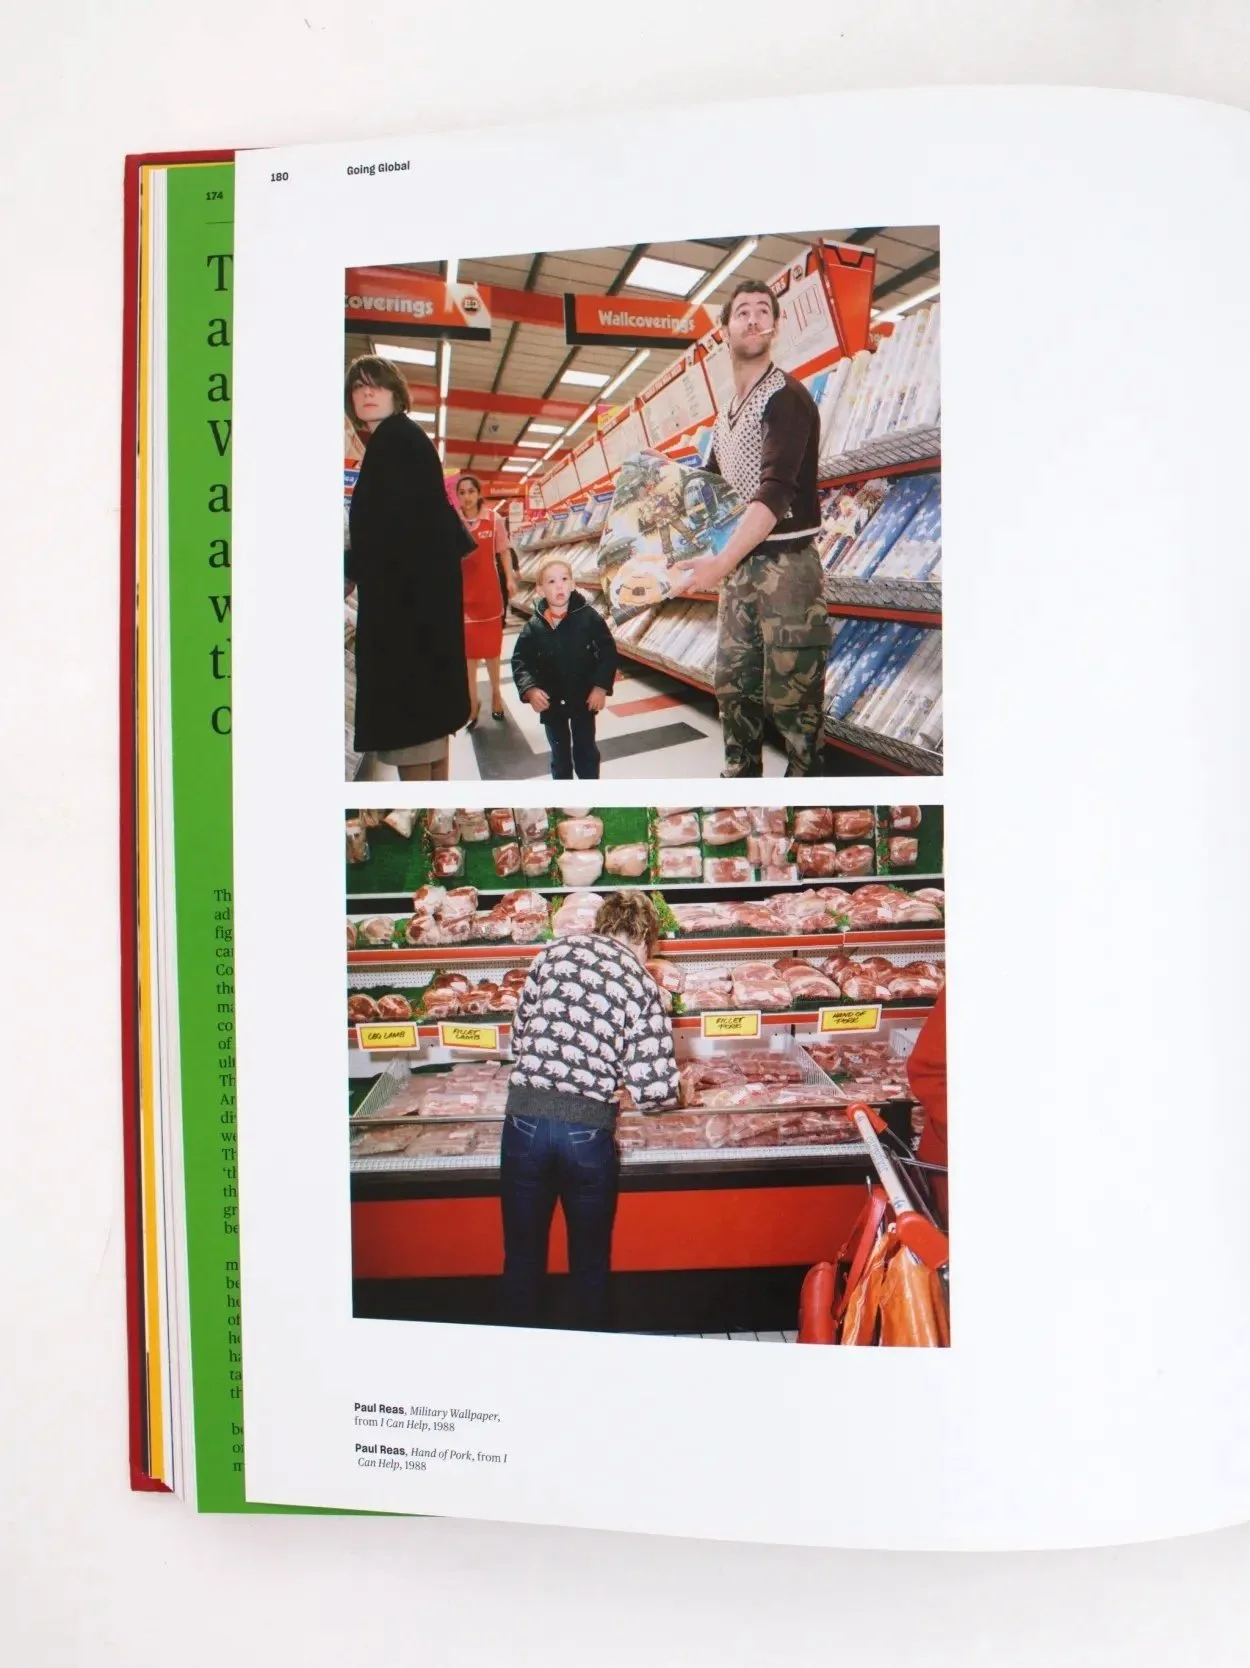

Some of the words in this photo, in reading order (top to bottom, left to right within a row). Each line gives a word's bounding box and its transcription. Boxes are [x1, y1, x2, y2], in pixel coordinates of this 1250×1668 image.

[347, 164, 375, 176] Going
[378, 161, 410, 172] Global
[271, 172, 289, 182] 180
[206, 191, 223, 201] 174
[597, 310, 696, 333] Wallcoverings
[354, 1402, 376, 1412] Paul
[379, 1404, 407, 1416] Reas,
[410, 1406, 448, 1420] Military
[450, 1409, 500, 1422] Wallpaper,
[355, 1416, 378, 1426] from
[381, 1418, 384, 1427] I
[386, 1419, 404, 1428] Can
[407, 1420, 430, 1432] Help,
[434, 1422, 455, 1431] 1988
[355, 1443, 377, 1454] Paul
[380, 1445, 408, 1457] Reas,
[411, 1448, 436, 1457] Hand
[439, 1449, 449, 1460] of
[450, 1450, 475, 1462] Pork,
[477, 1452, 500, 1462] from
[504, 1454, 507, 1463] I
[358, 1458, 376, 1467] Can
[379, 1459, 402, 1471] Help,
[405, 1461, 426, 1470] 1988
